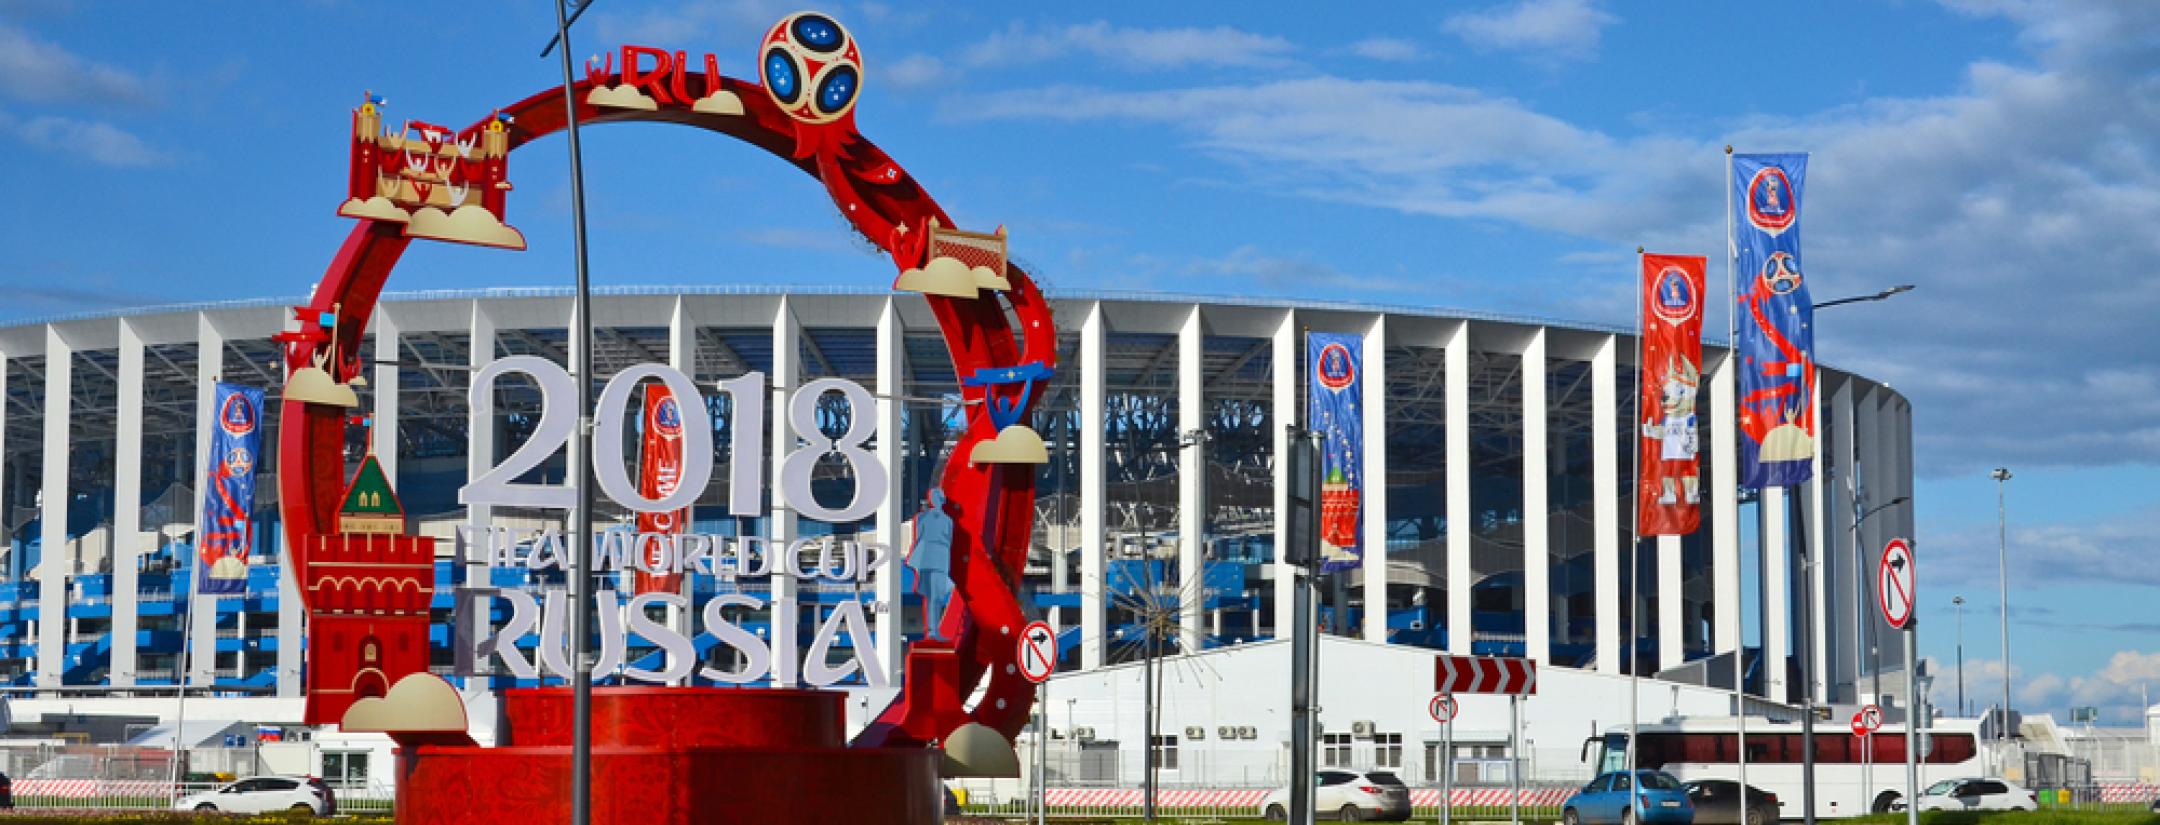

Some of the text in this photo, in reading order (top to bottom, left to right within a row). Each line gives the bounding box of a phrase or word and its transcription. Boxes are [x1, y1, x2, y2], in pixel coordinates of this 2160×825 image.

[458, 356, 889, 522] 2018
[456, 525, 890, 582] FIFA WORLD CUP
[455, 587, 889, 688] RUSSIA
